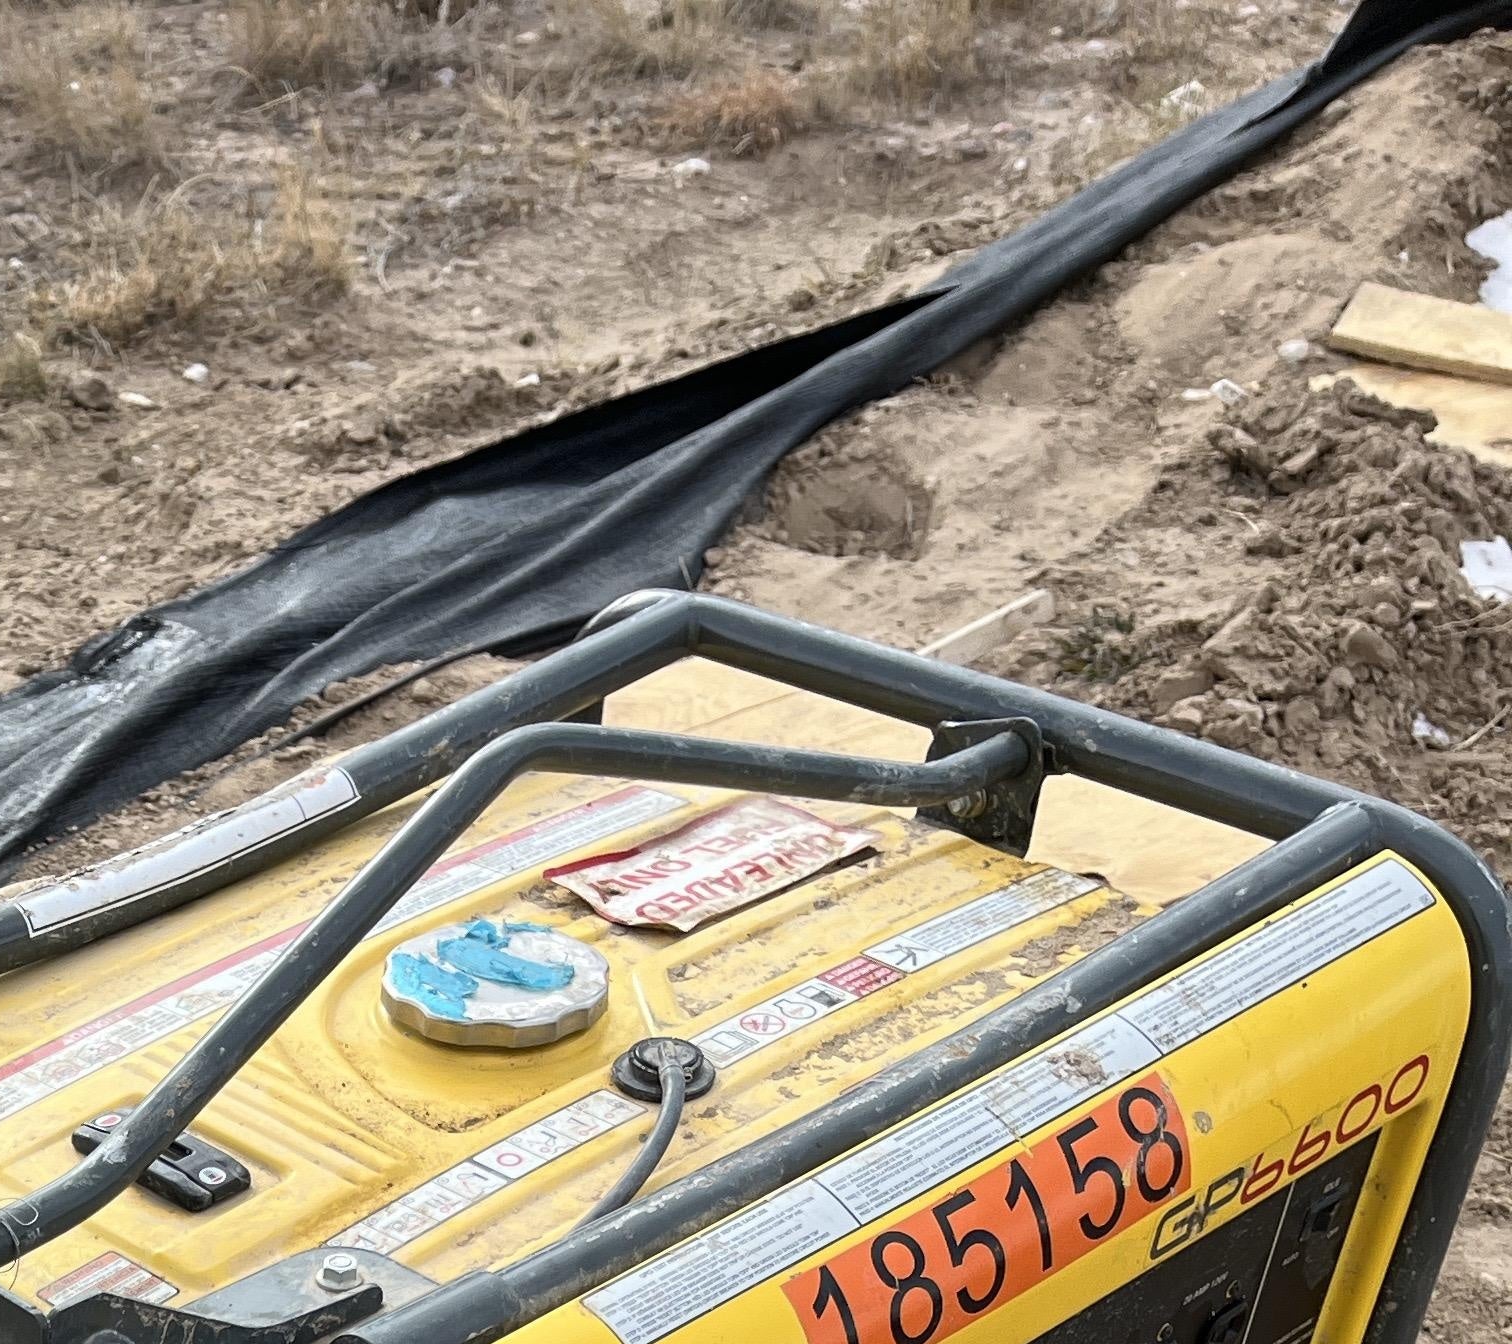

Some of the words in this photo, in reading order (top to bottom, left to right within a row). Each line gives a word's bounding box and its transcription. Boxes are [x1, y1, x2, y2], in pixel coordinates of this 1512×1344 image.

[586, 856, 694, 904] ONLY
[634, 832, 846, 924] UNLEADED
[1149, 1054, 1429, 1262] GP6600
